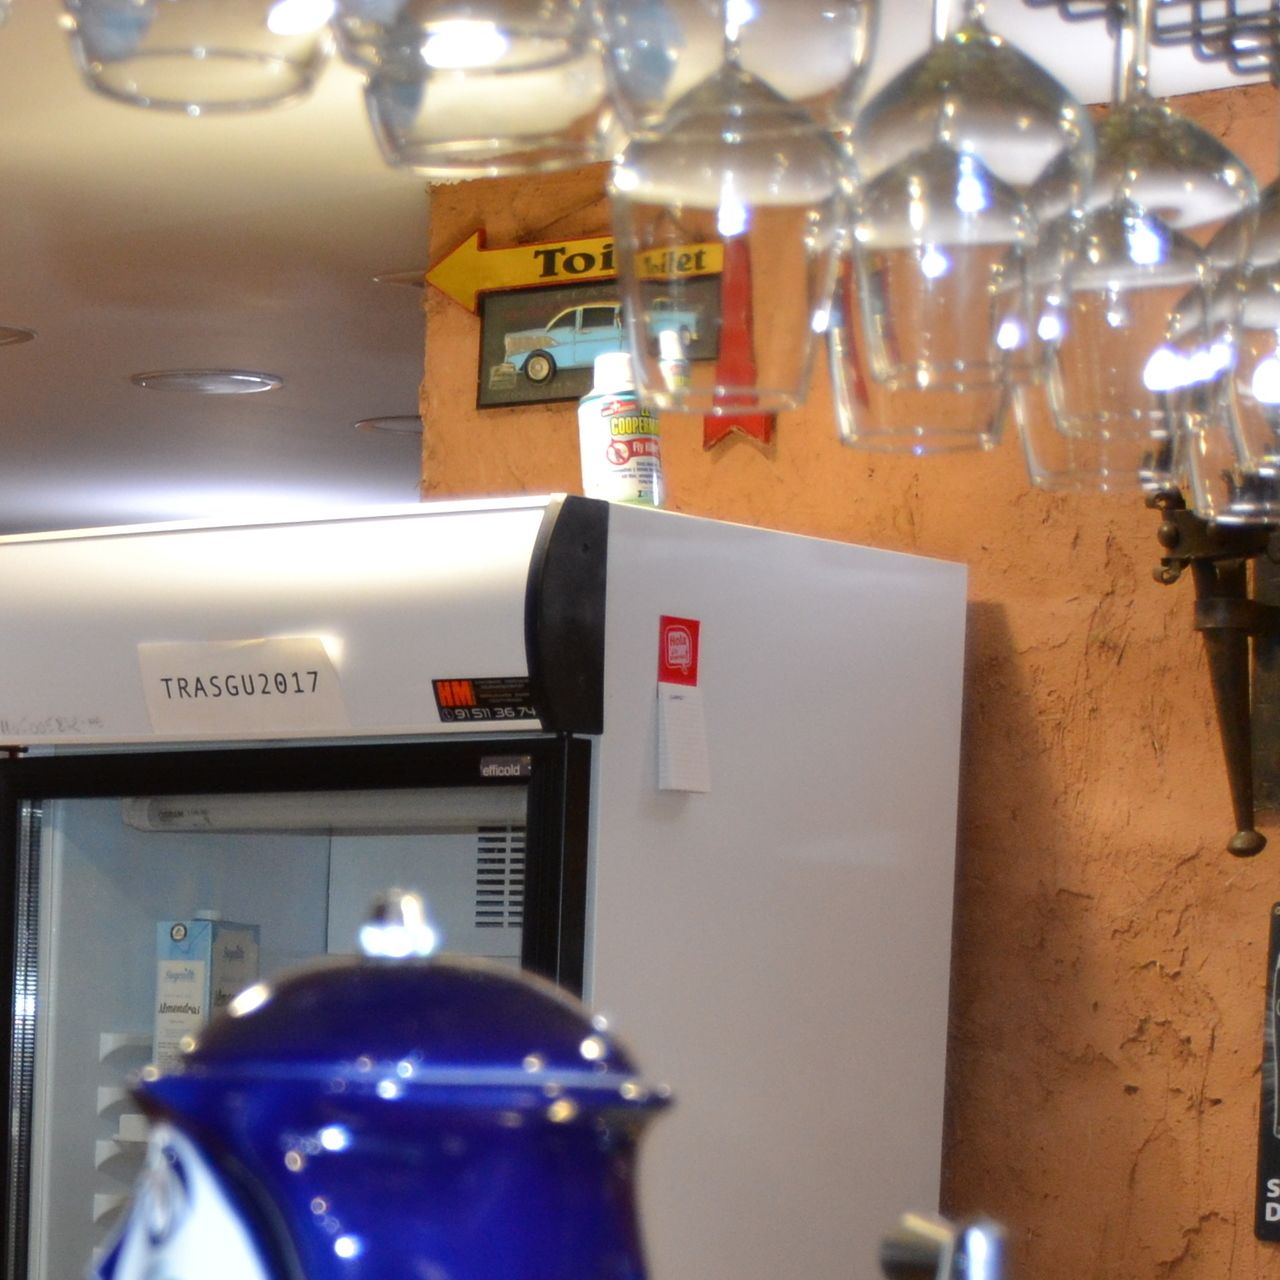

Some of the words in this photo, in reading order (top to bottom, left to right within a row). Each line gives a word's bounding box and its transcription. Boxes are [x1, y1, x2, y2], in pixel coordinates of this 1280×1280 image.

[160, 671, 319, 700] TRASGU2017
[436, 679, 476, 707] HM
[455, 708, 469, 720] 91
[471, 708, 491, 720] 511
[494, 707, 515, 719] 36
[517, 706, 536, 718] 74
[482, 764, 521, 777] efficold
